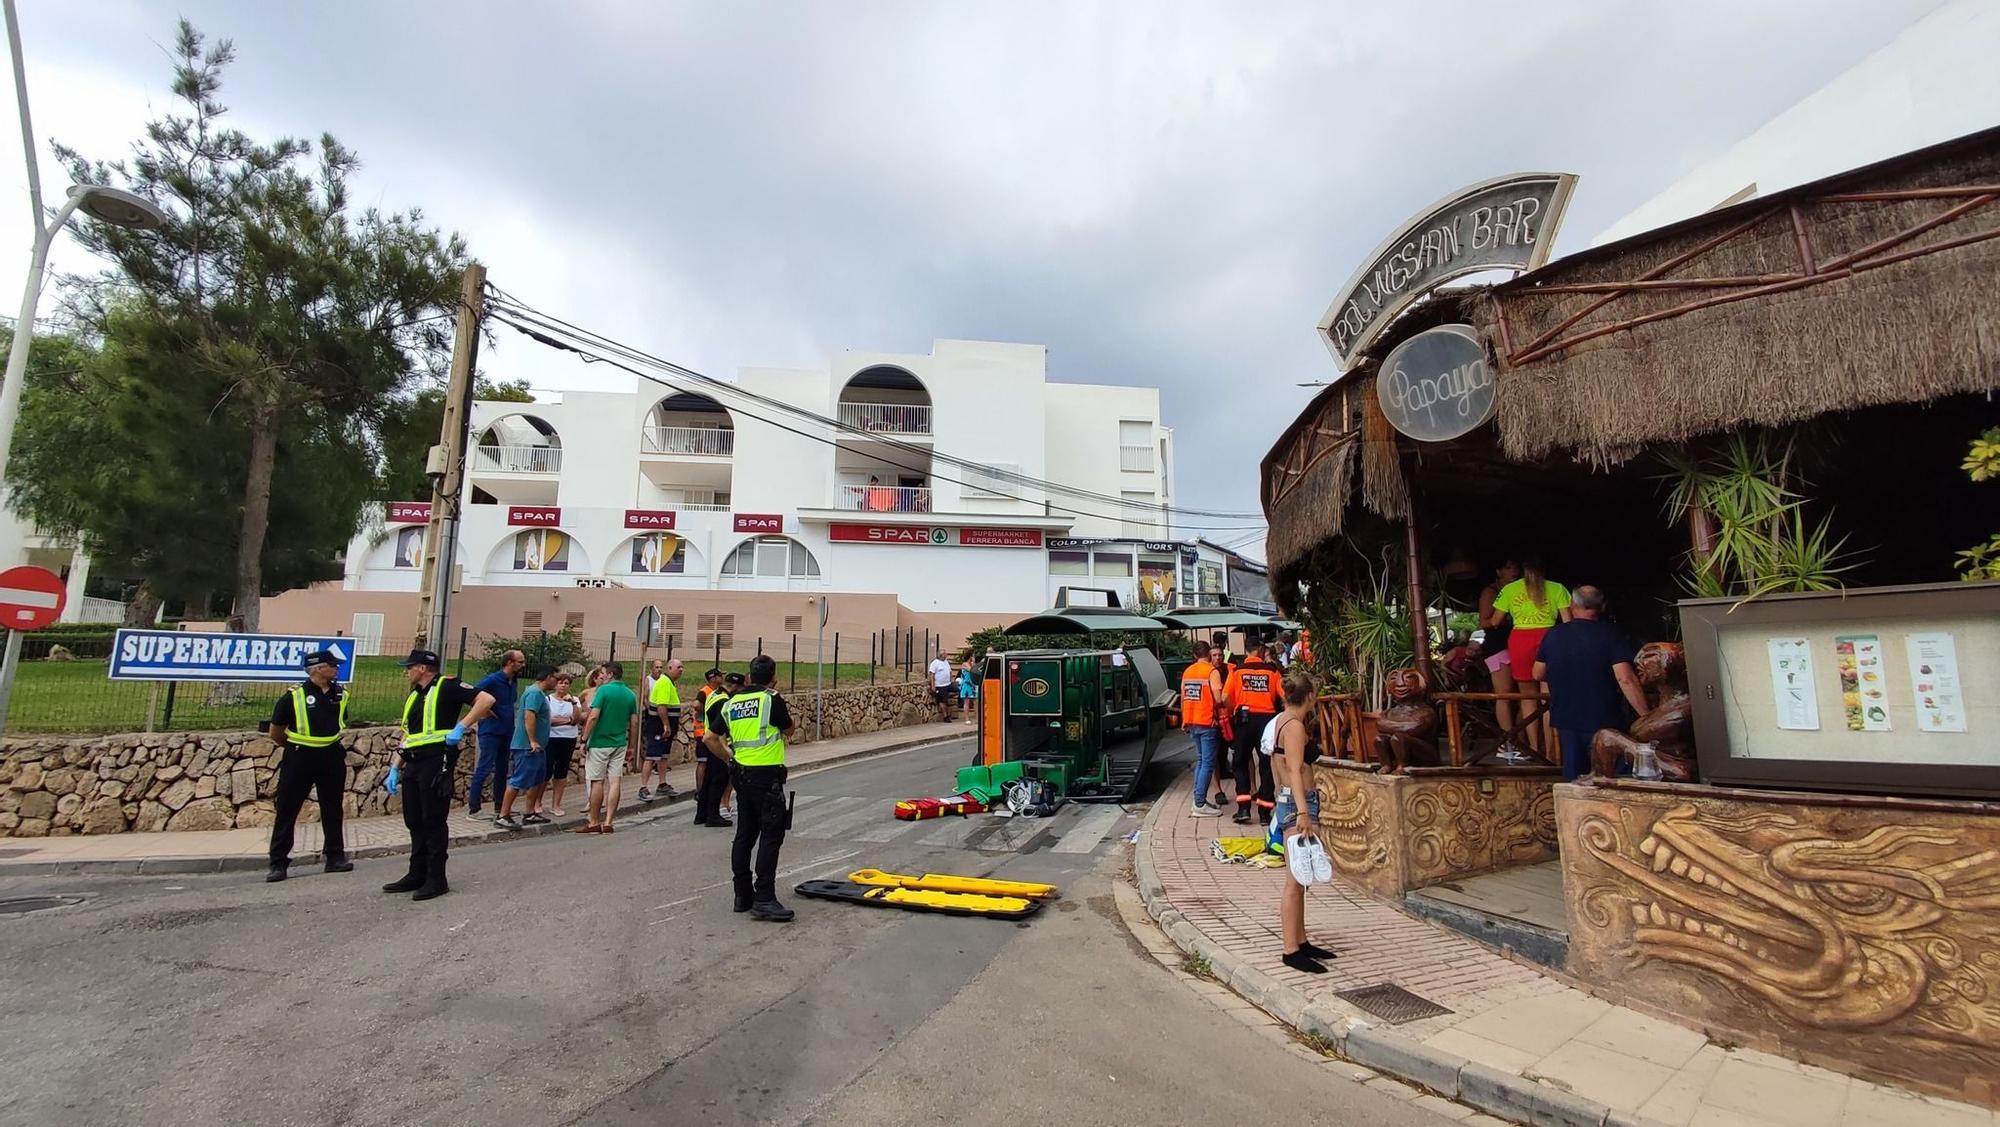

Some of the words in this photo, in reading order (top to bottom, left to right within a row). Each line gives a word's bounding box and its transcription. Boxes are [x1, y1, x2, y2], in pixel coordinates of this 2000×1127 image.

[1469, 197, 1540, 249] BAR
[1387, 359, 1491, 428] Papaya
[512, 512, 556, 521] SPAR
[629, 515, 671, 524] SPAR
[737, 518, 778, 528] SPAR
[868, 528, 929, 541] SPAR
[972, 530, 1029, 538] SUPERMARKET
[967, 536, 1003, 544] FERRERA
[1049, 539, 1077, 547] COLD
[121, 634, 320, 667] SUPERMARKET
[1250, 680, 1268, 688] CIVIL
[729, 700, 759, 711] POLICIA
[737, 708, 758, 718] LOCAL
